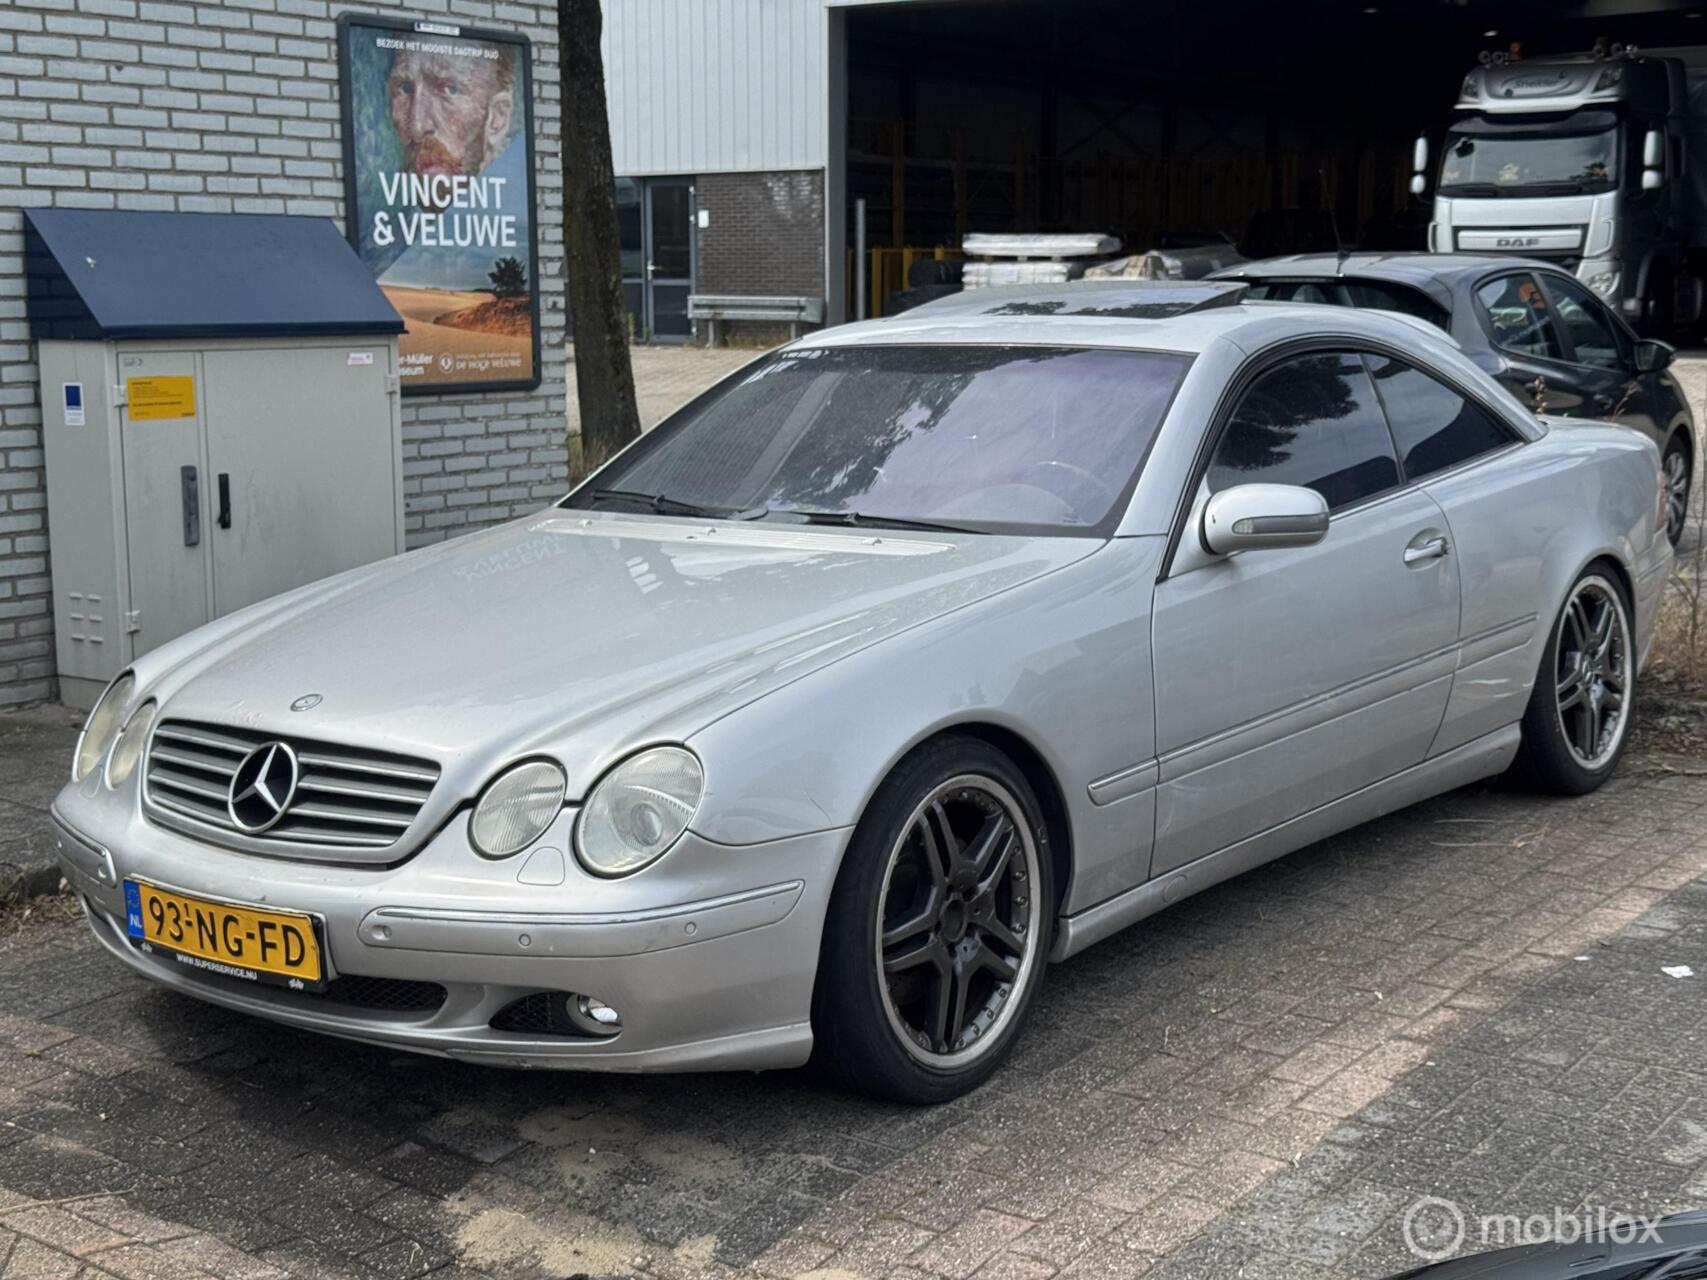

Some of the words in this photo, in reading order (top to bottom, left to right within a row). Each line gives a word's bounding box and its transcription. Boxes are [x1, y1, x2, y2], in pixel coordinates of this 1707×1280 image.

[376, 37, 404, 50] BEZOEK
[405, 41, 420, 51] HET
[379, 171, 507, 209] VINCENT
[373, 210, 395, 246] &
[397, 211, 517, 247] VELUWE
[1496, 238, 1539, 248] DAF
[130, 913, 143, 929] NL
[149, 896, 305, 967] 93-NG-FD
